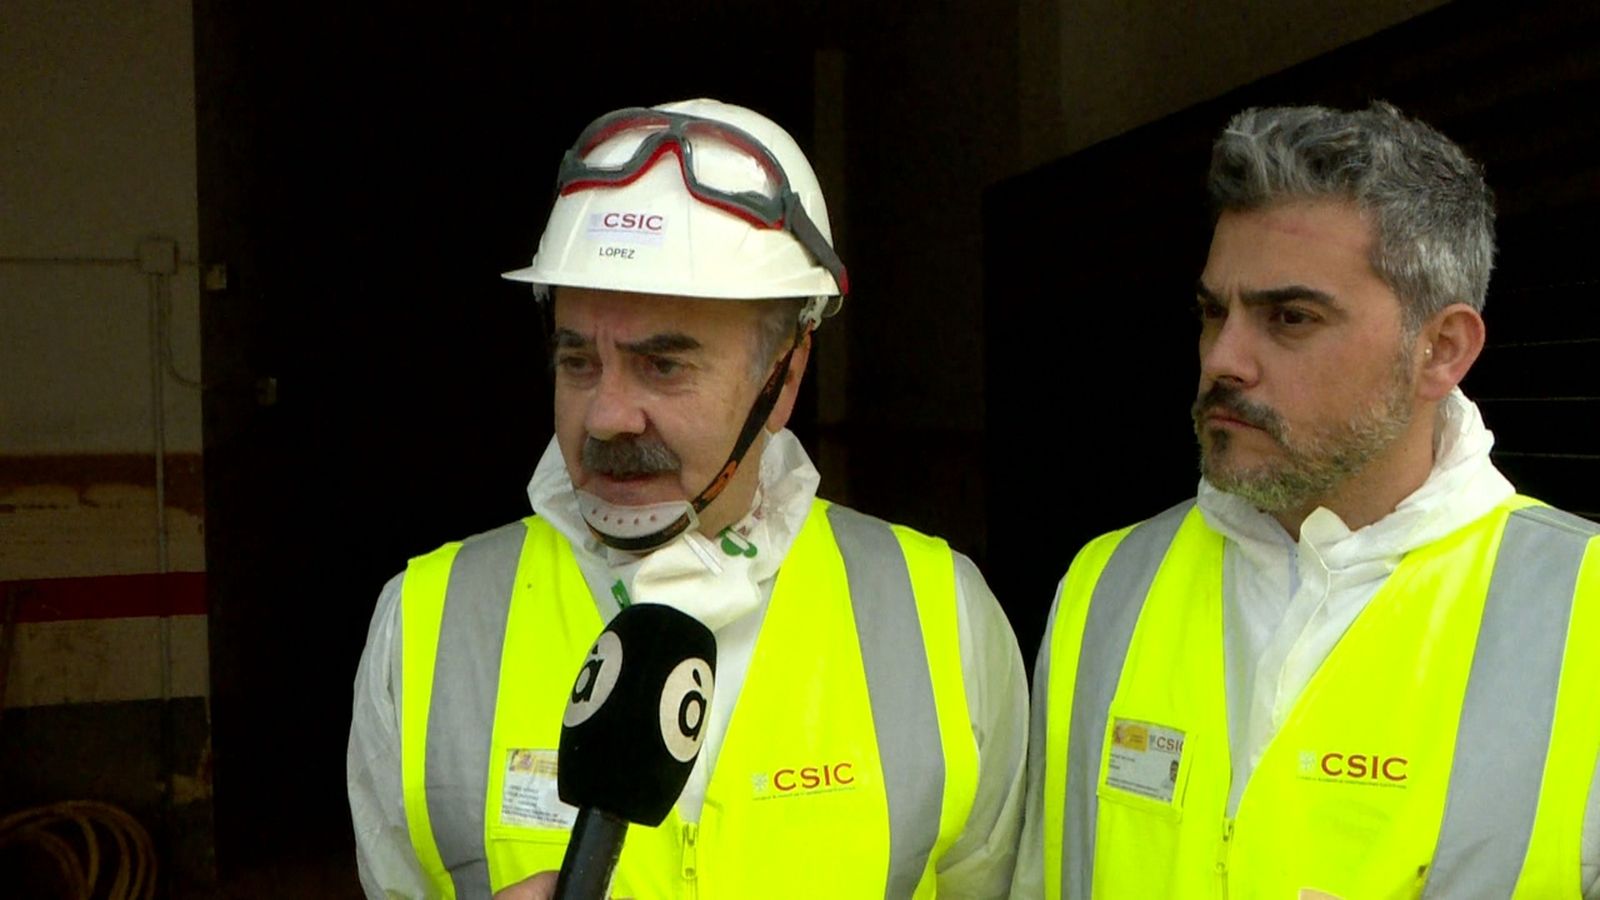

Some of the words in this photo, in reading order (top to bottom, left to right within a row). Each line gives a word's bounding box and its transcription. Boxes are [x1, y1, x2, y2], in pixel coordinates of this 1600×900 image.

[604, 213, 663, 231] CSIC
[599, 247, 636, 259] LOPEZ
[1156, 735, 1184, 753] CSI
[1320, 752, 1408, 782] CSIC
[773, 762, 854, 791] CSIC
